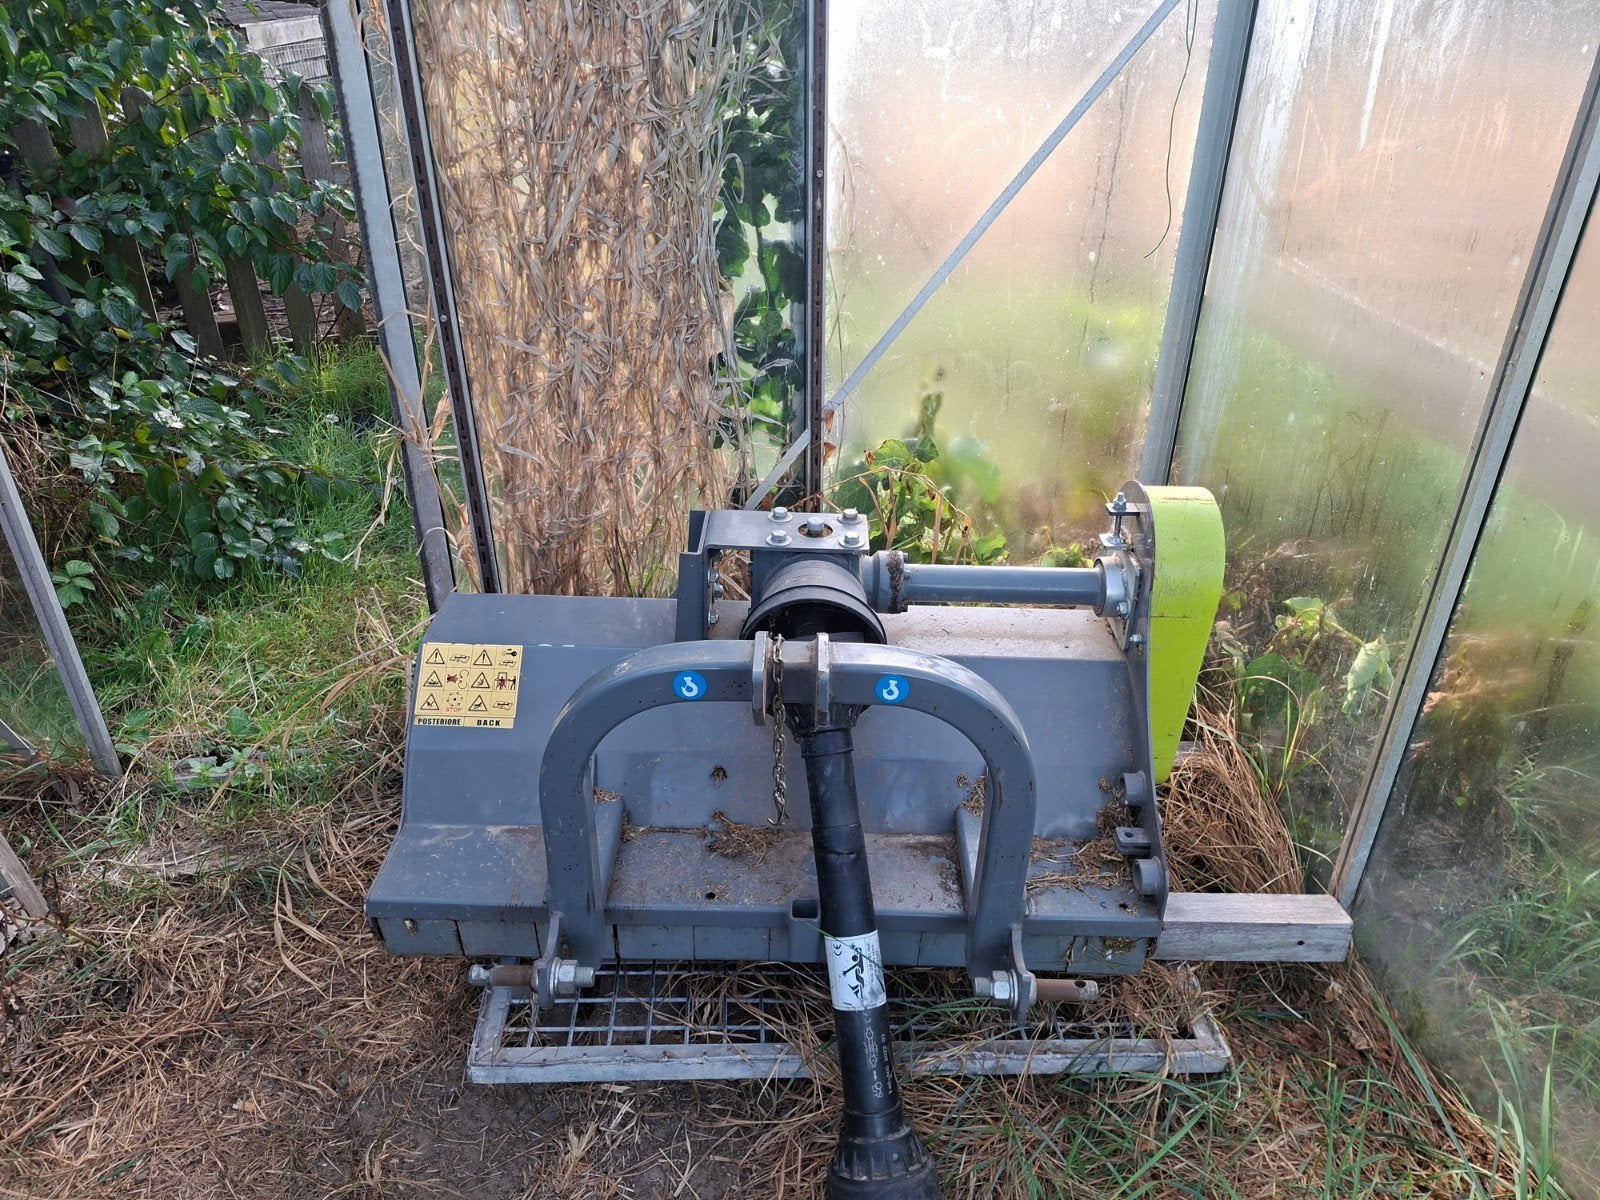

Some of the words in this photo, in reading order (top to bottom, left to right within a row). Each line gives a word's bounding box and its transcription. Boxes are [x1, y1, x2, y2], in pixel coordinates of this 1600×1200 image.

[417, 717, 461, 726] POSTERIORE
[476, 719, 501, 727] BACK
[832, 944, 842, 956] CE
